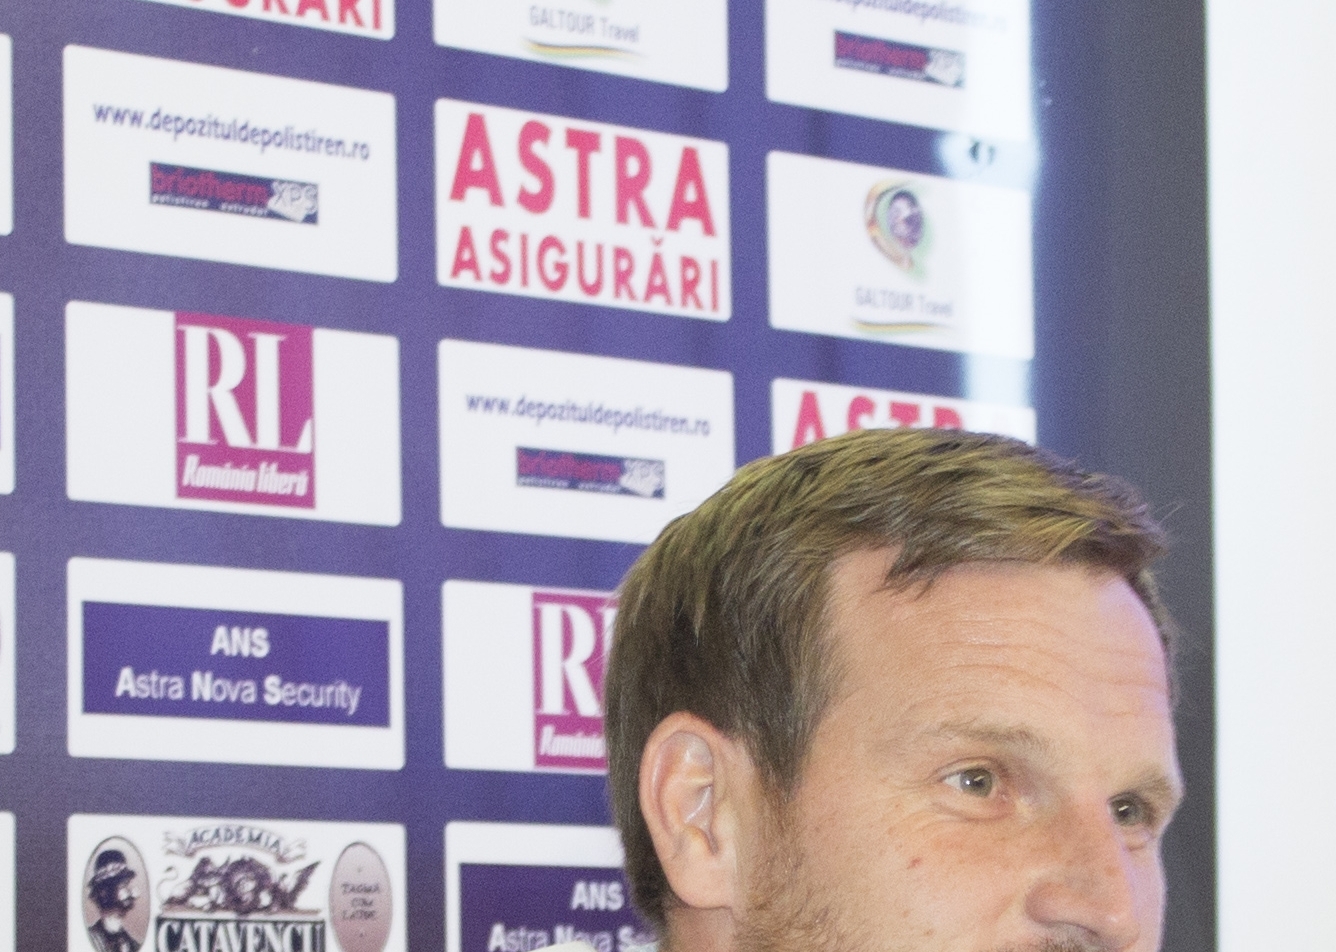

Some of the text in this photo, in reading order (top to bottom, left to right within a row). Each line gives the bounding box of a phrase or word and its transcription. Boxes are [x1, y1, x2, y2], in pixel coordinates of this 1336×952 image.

[92, 102, 371, 161] www.depozituldepolistiren.ro
[450, 112, 717, 237] ASTRA
[450, 225, 719, 313] ASIGURĂRI
[177, 324, 312, 454] RL
[210, 624, 270, 659] ANS
[115, 666, 362, 716] Astra Nova Security
[571, 881, 624, 910] ANS
